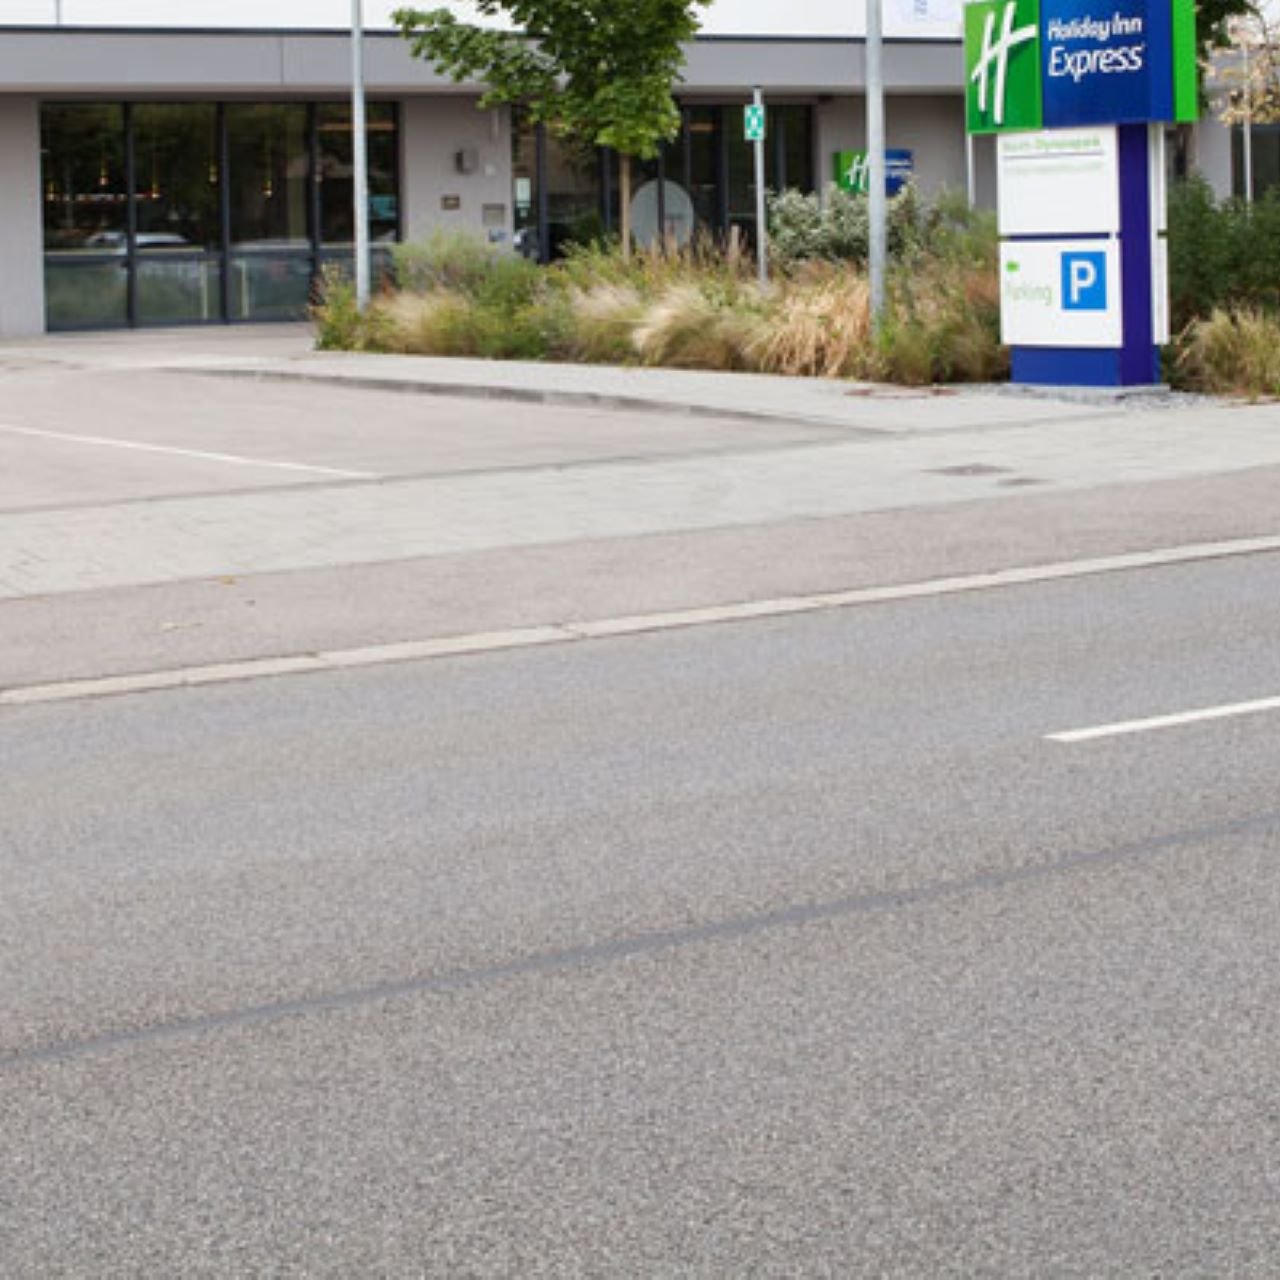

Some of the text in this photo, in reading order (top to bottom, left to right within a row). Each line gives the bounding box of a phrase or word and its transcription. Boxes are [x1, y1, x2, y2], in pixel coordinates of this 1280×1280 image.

[1048, 11, 1142, 41] Holiday Inn
[1048, 45, 1142, 83] Express
[1070, 260, 1097, 304] P
